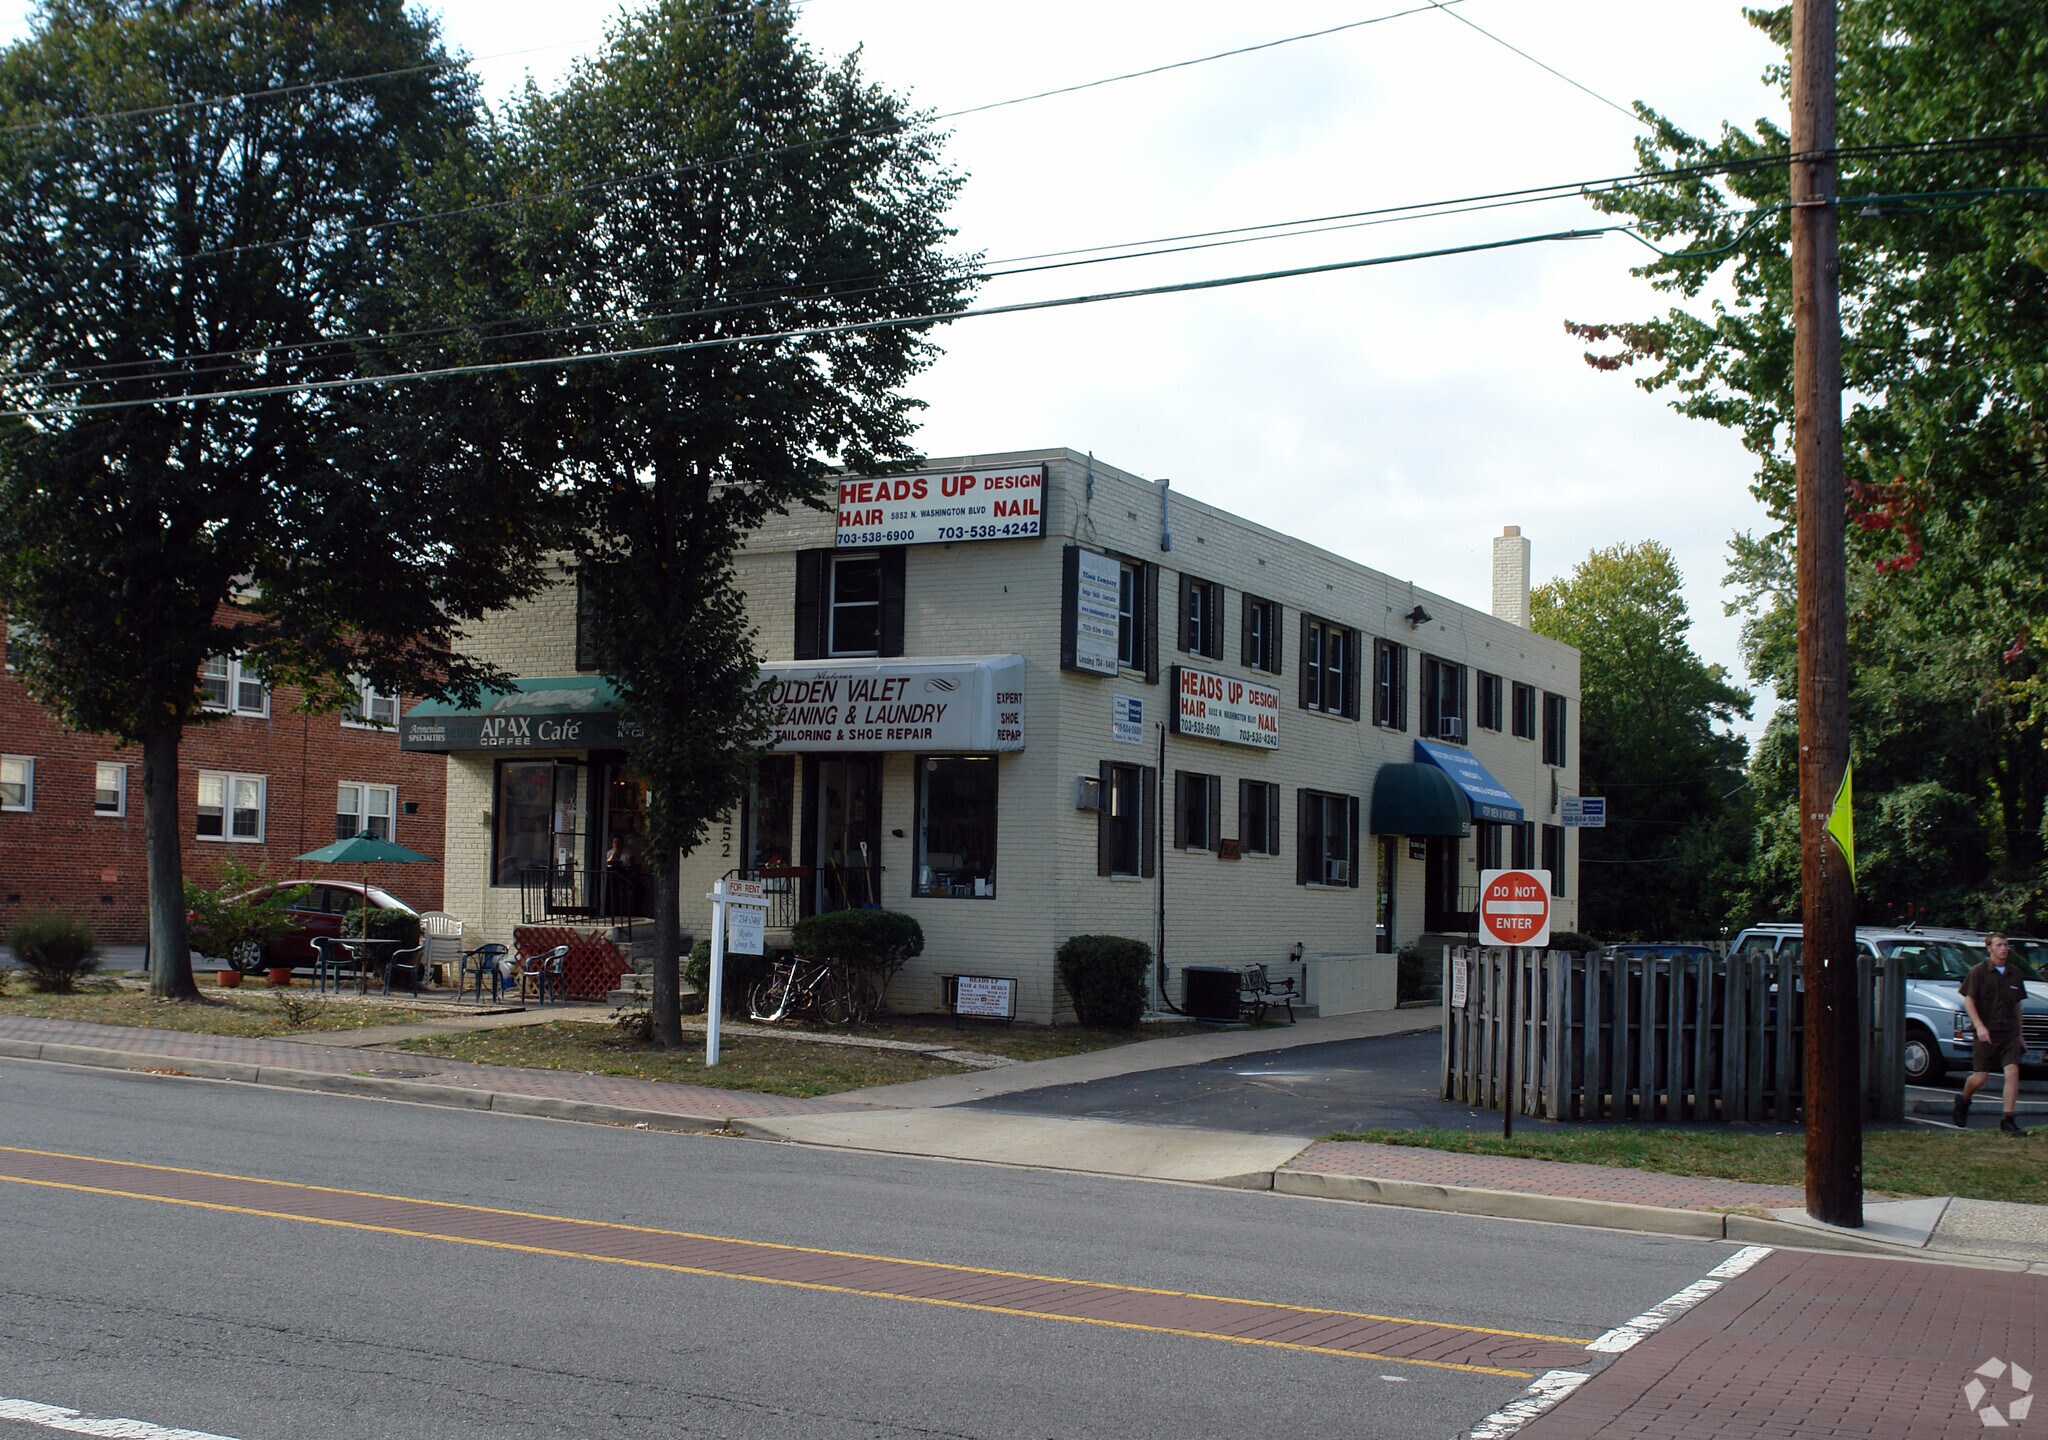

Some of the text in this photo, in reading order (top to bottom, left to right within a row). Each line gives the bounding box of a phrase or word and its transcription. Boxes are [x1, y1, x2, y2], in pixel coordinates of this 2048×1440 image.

[840, 474, 1041, 504] HEADS UP DESIGN
[838, 498, 1040, 527] HAIR 5852 N. WASHINGTON BLVD NAIL
[837, 521, 1038, 544] 703-538-6900 703-538-4242
[1097, 576, 1117, 588] Company
[848, 678, 910, 702] VALET
[1181, 671, 1278, 709] HEADS UP DESIGN
[997, 692, 1022, 704] EXPERT
[845, 705, 857, 725] &
[865, 703, 948, 724] LAUNDRY
[1001, 712, 1019, 724] SHOE
[1181, 697, 1206, 719] HAIR
[1224, 710, 1247, 723] WASHINGTON
[1258, 713, 1277, 733] NAIL
[409, 724, 445, 733] Armenian
[480, 717, 531, 737] APAX
[538, 720, 583, 741] Café
[775, 730, 831, 741] TAILORING
[837, 729, 844, 741] &
[849, 728, 882, 740] SHOE
[887, 727, 932, 740] REPAIR
[1181, 718, 1277, 746] 703-538-6900 703-538-4242
[480, 737, 531, 745] COFFEE
[1482, 806, 1490, 816] FOR
[730, 882, 760, 894] FOR RENT
[1493, 886, 1537, 898] DO NOT
[1496, 918, 1532, 929] ENTER
